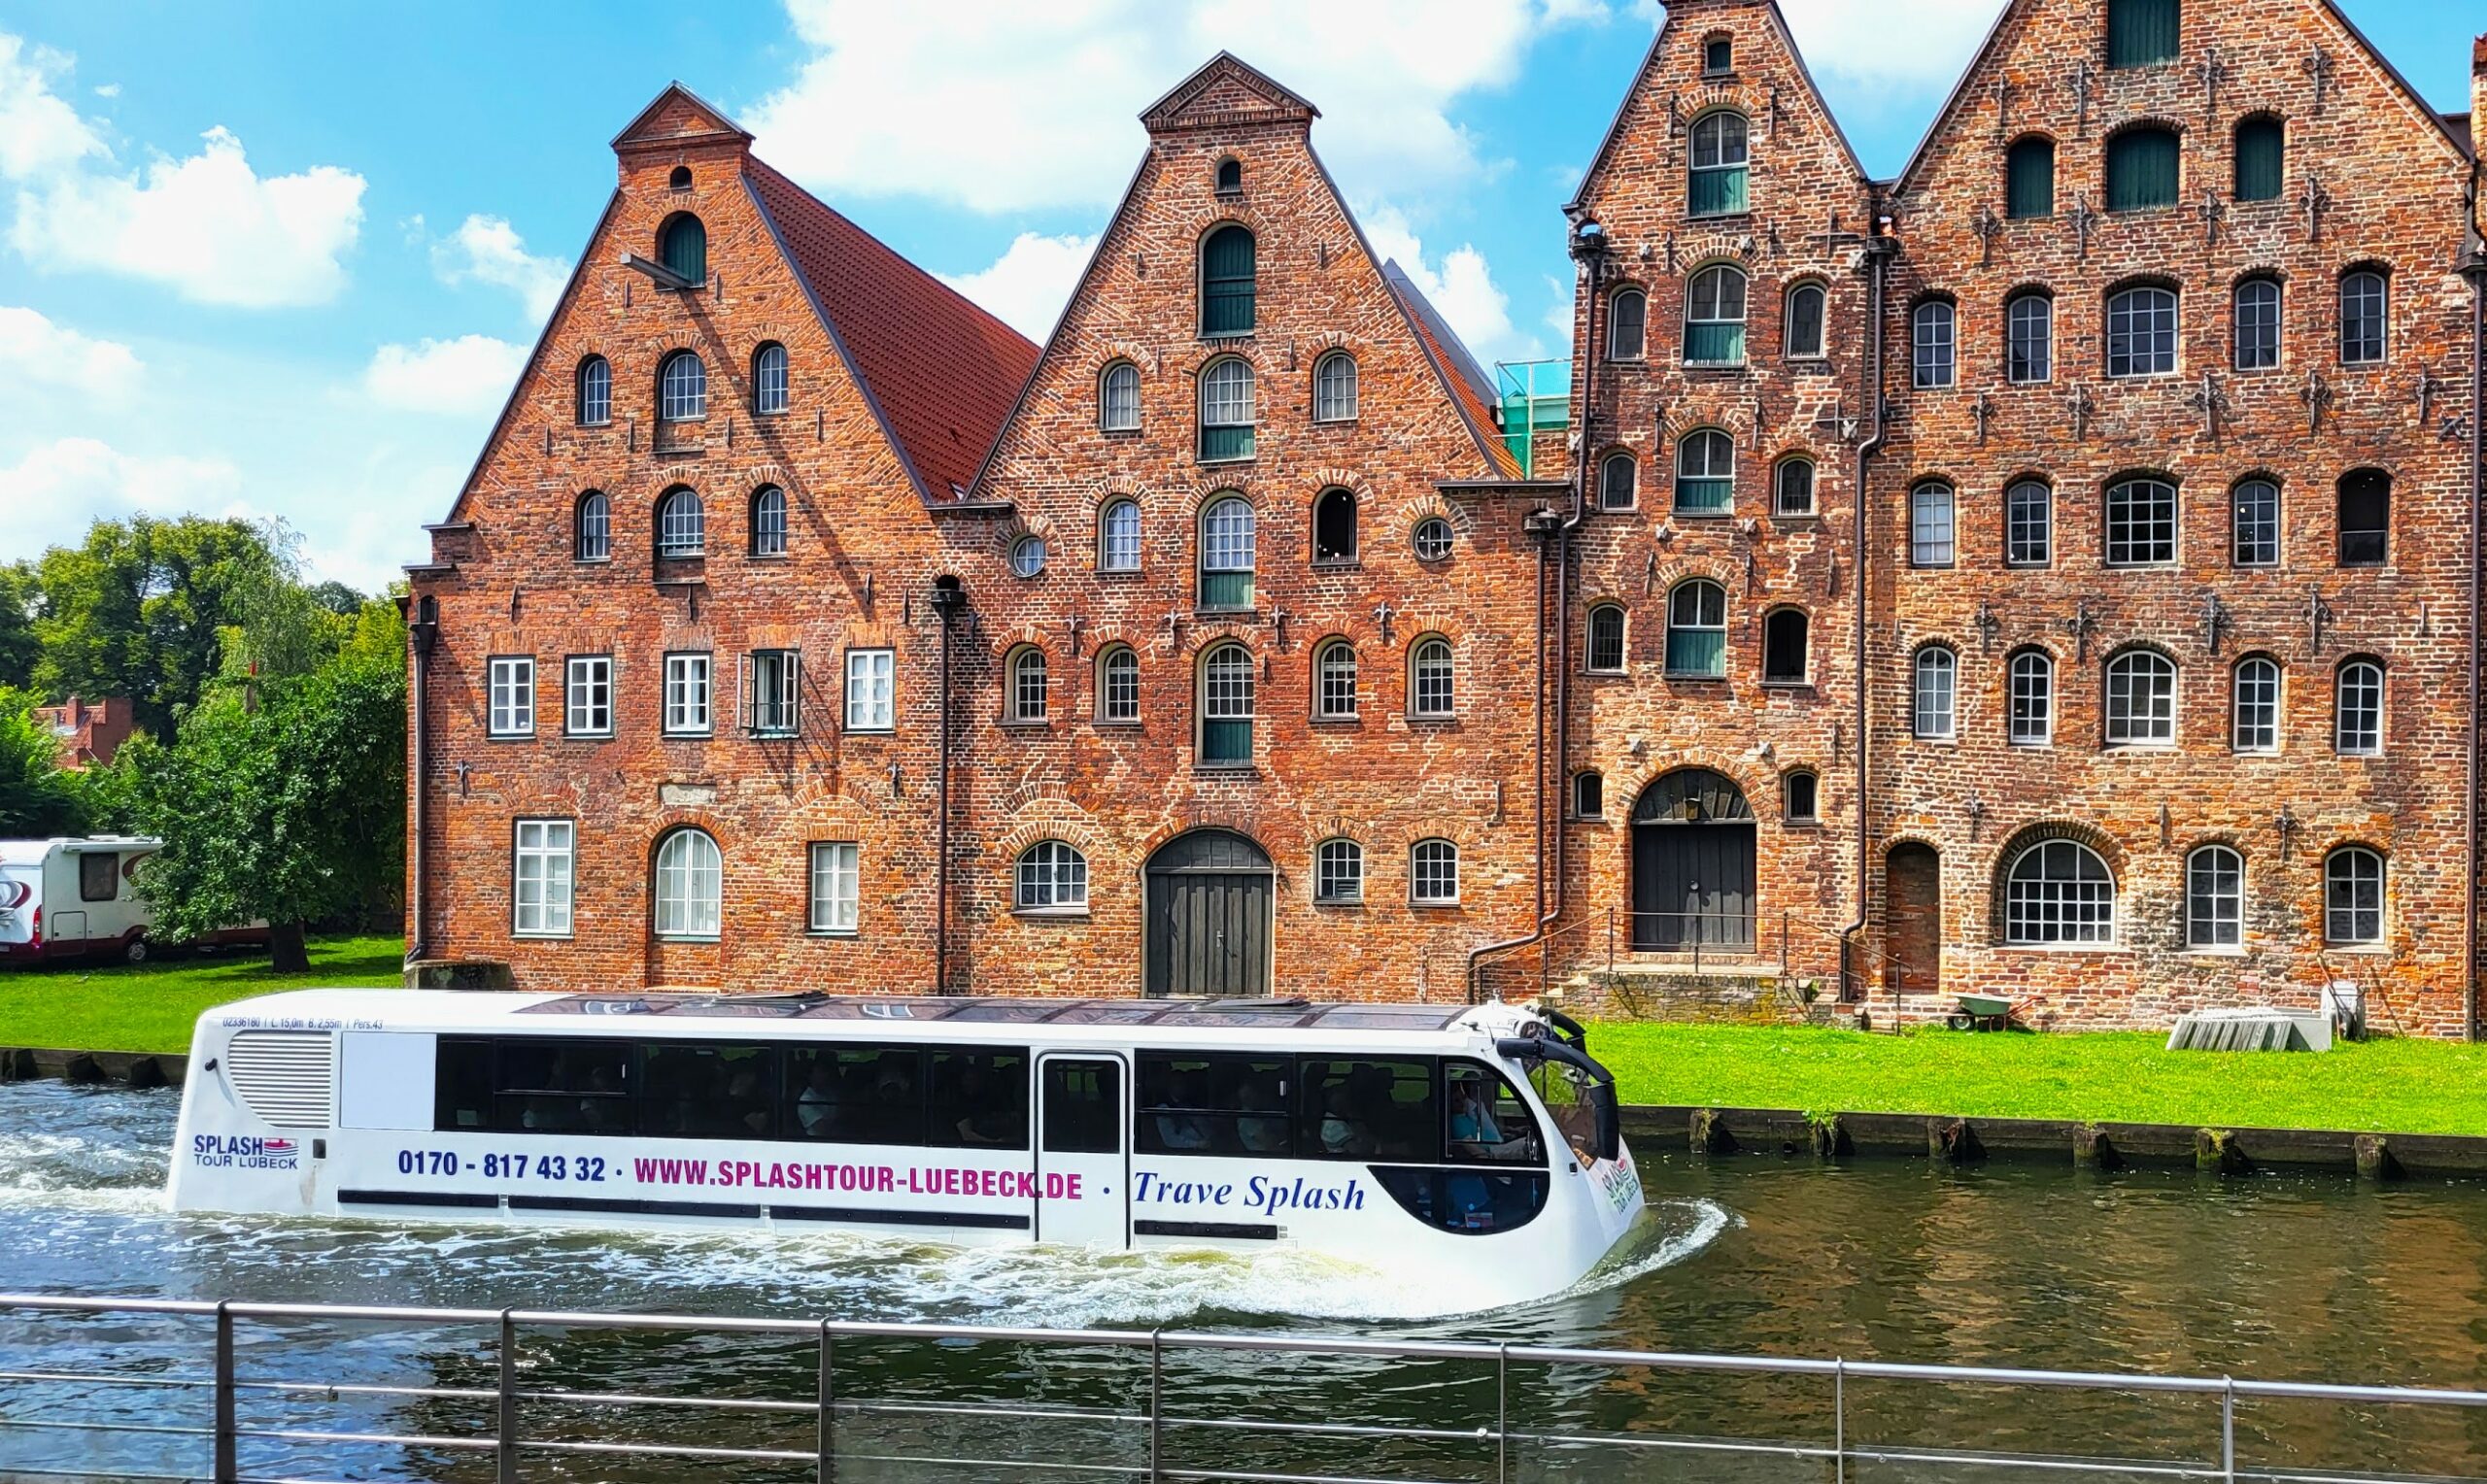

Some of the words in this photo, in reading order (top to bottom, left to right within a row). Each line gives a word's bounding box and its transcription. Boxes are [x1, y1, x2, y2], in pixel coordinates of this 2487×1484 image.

[194, 1134, 263, 1156] SPLASH
[194, 1154, 232, 1166] TOUR
[239, 1157, 298, 1169] LÜBECK
[398, 1150, 458, 1176] 0170
[484, 1153, 528, 1178] 817
[536, 1156, 566, 1180] 43
[575, 1157, 605, 1182] 32
[634, 1158, 1082, 1200] WWW.SPLASHTOUR-LUEBECK.DE
[1134, 1172, 1233, 1205] Trave
[1244, 1175, 1364, 1216] Splash
